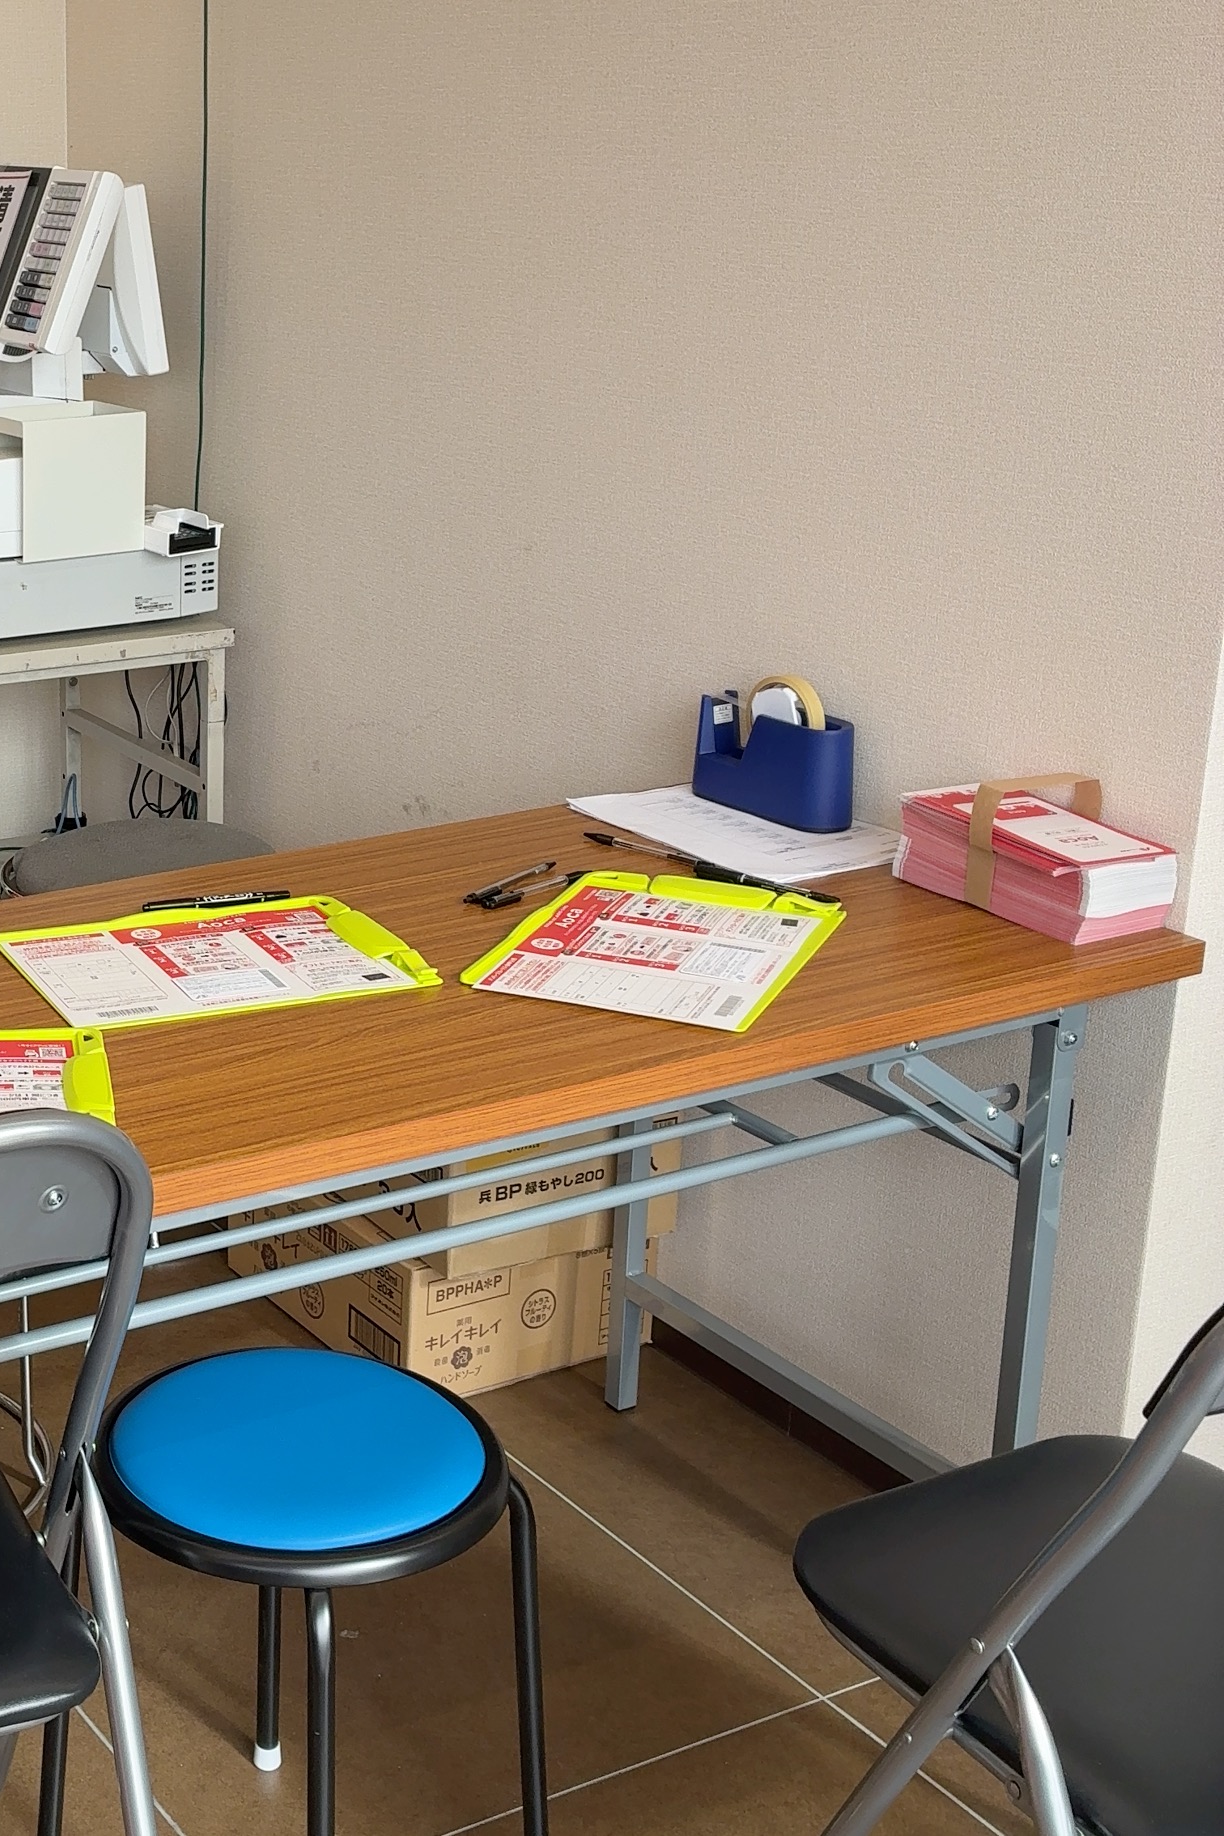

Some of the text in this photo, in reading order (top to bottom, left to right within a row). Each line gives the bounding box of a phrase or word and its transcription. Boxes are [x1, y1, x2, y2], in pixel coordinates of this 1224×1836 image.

[197, 917, 247, 929] Aoca
[554, 908, 585, 929] Aoca
[495, 1183, 522, 1201] BP
[425, 1318, 502, 1351] キレイキレイ
